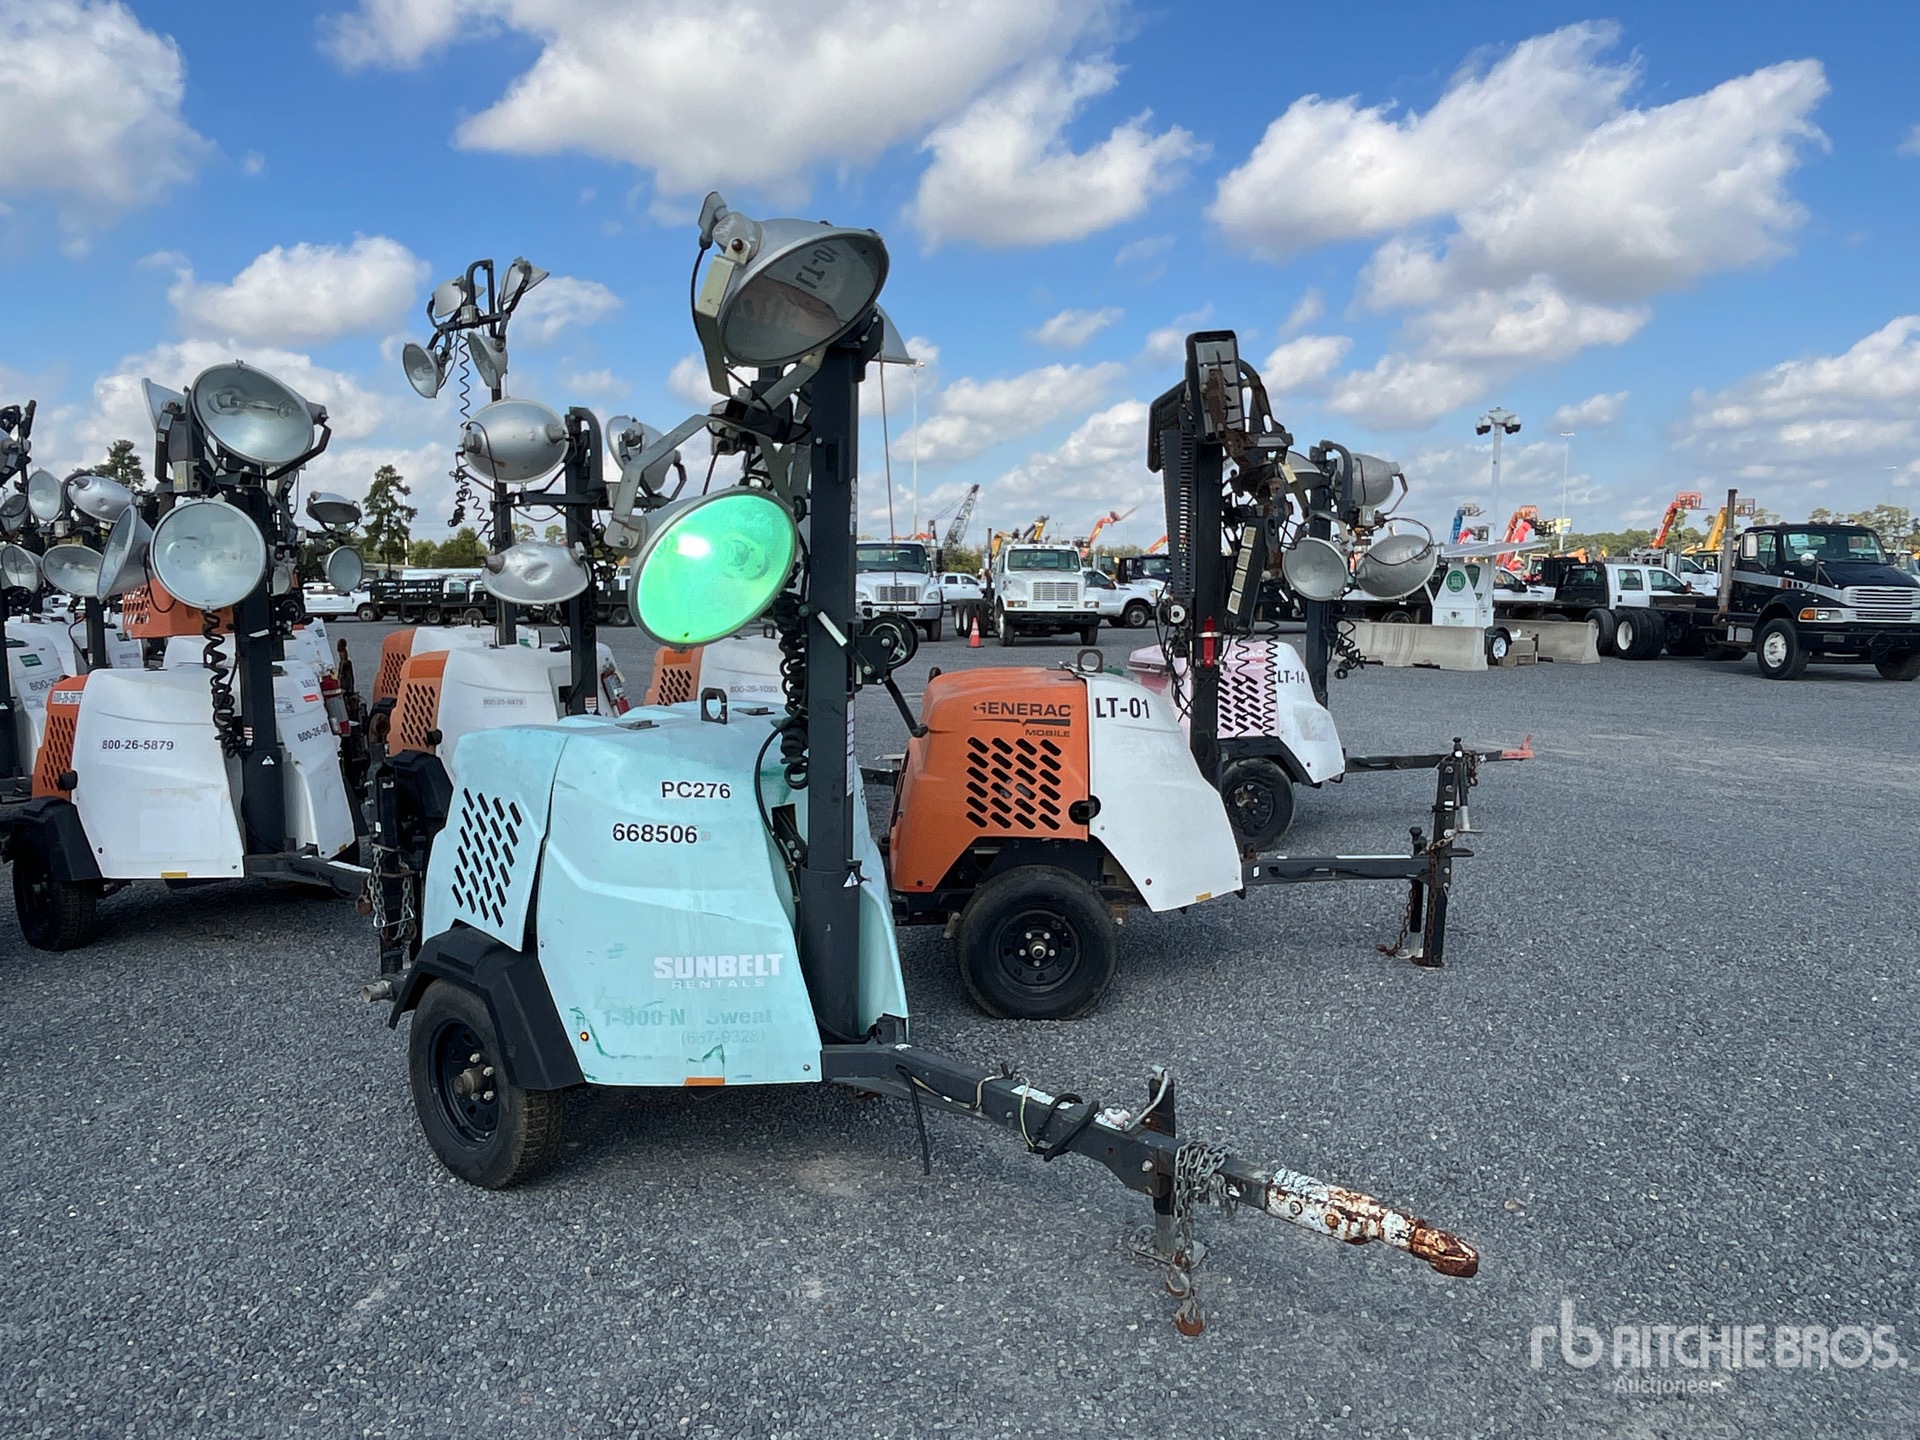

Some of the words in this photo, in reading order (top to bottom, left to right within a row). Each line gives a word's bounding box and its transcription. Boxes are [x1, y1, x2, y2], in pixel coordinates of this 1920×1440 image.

[1278, 671, 1305, 683] LT-14
[1096, 698, 1150, 719] LT-01
[1025, 729, 1070, 738] MOBILE
[102, 740, 174, 750] 800-26-5879
[661, 781, 731, 799] PC276
[612, 823, 698, 844] 668506
[653, 953, 784, 979] SUNBELT
[671, 978, 765, 989] RENTALS
